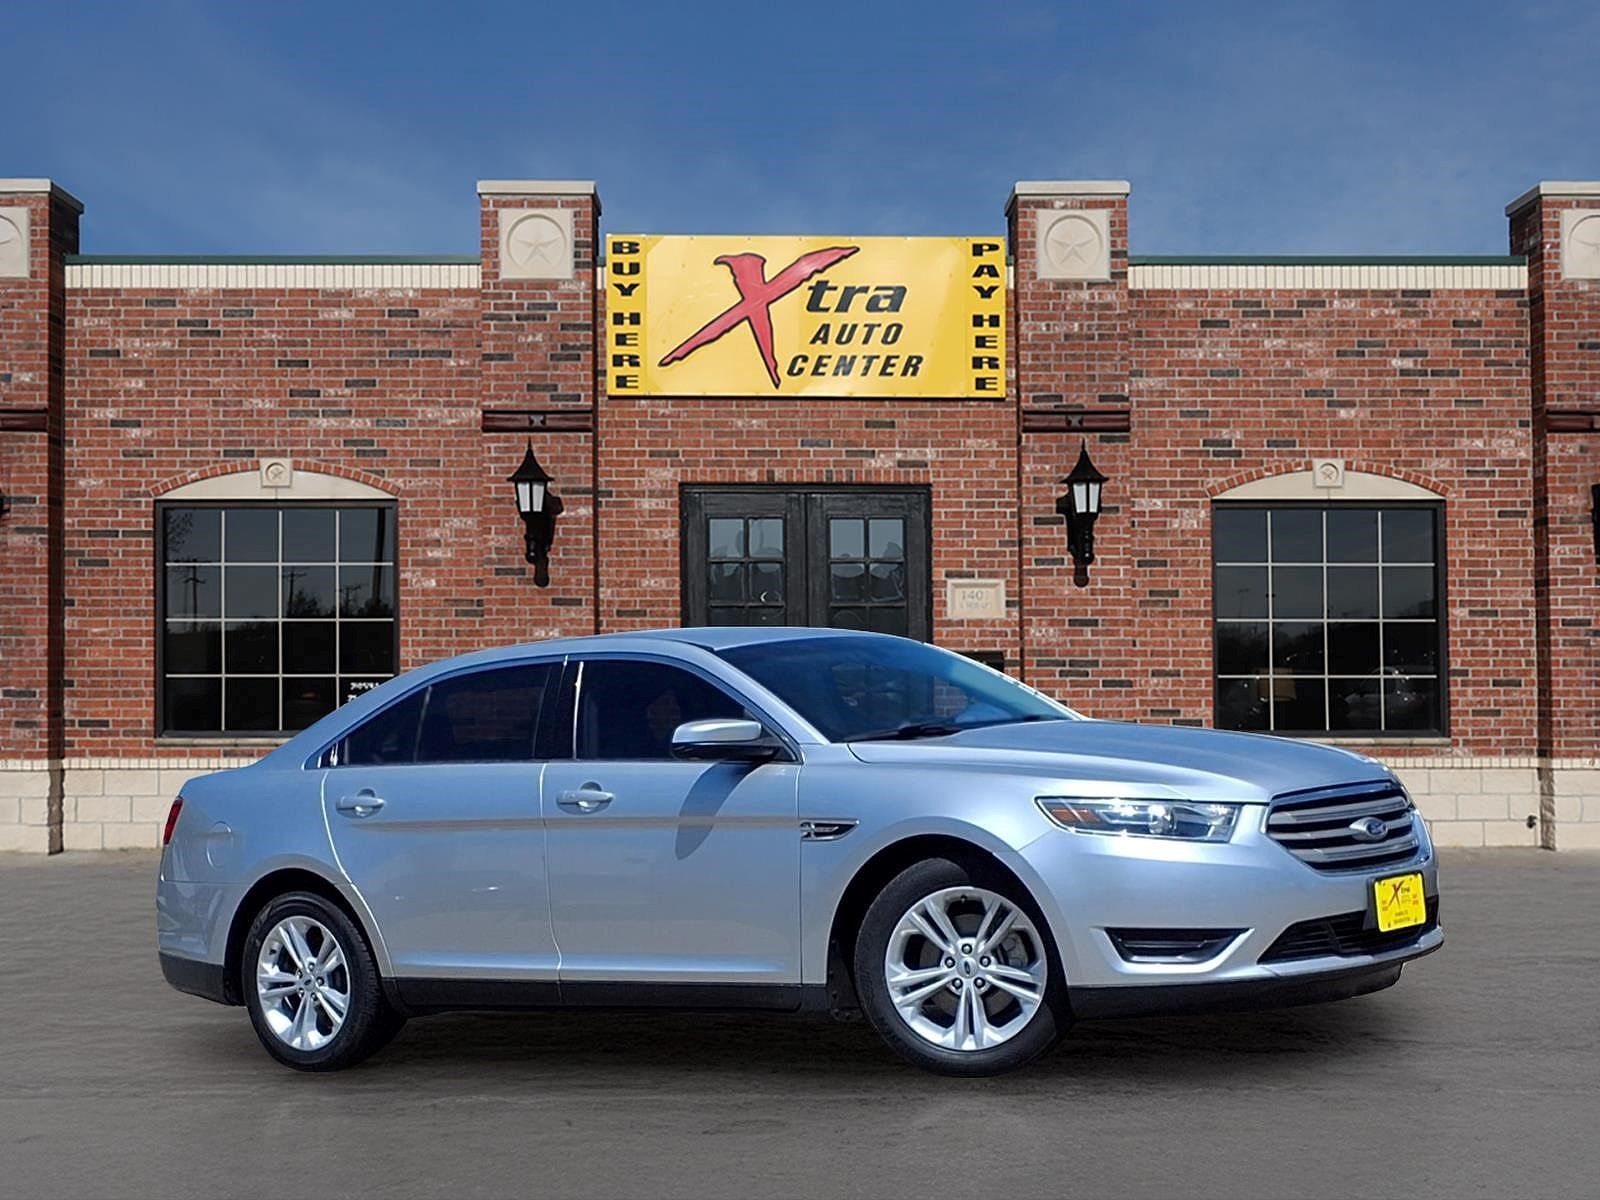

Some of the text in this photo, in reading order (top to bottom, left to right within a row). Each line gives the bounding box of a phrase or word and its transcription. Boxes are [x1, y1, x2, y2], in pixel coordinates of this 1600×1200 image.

[612, 241, 641, 389] BUY HERE
[658, 246, 908, 390] Xtra
[786, 354, 924, 378] CENTER
[809, 322, 904, 346] AUTO
[972, 243, 1001, 391] PAY HERE
